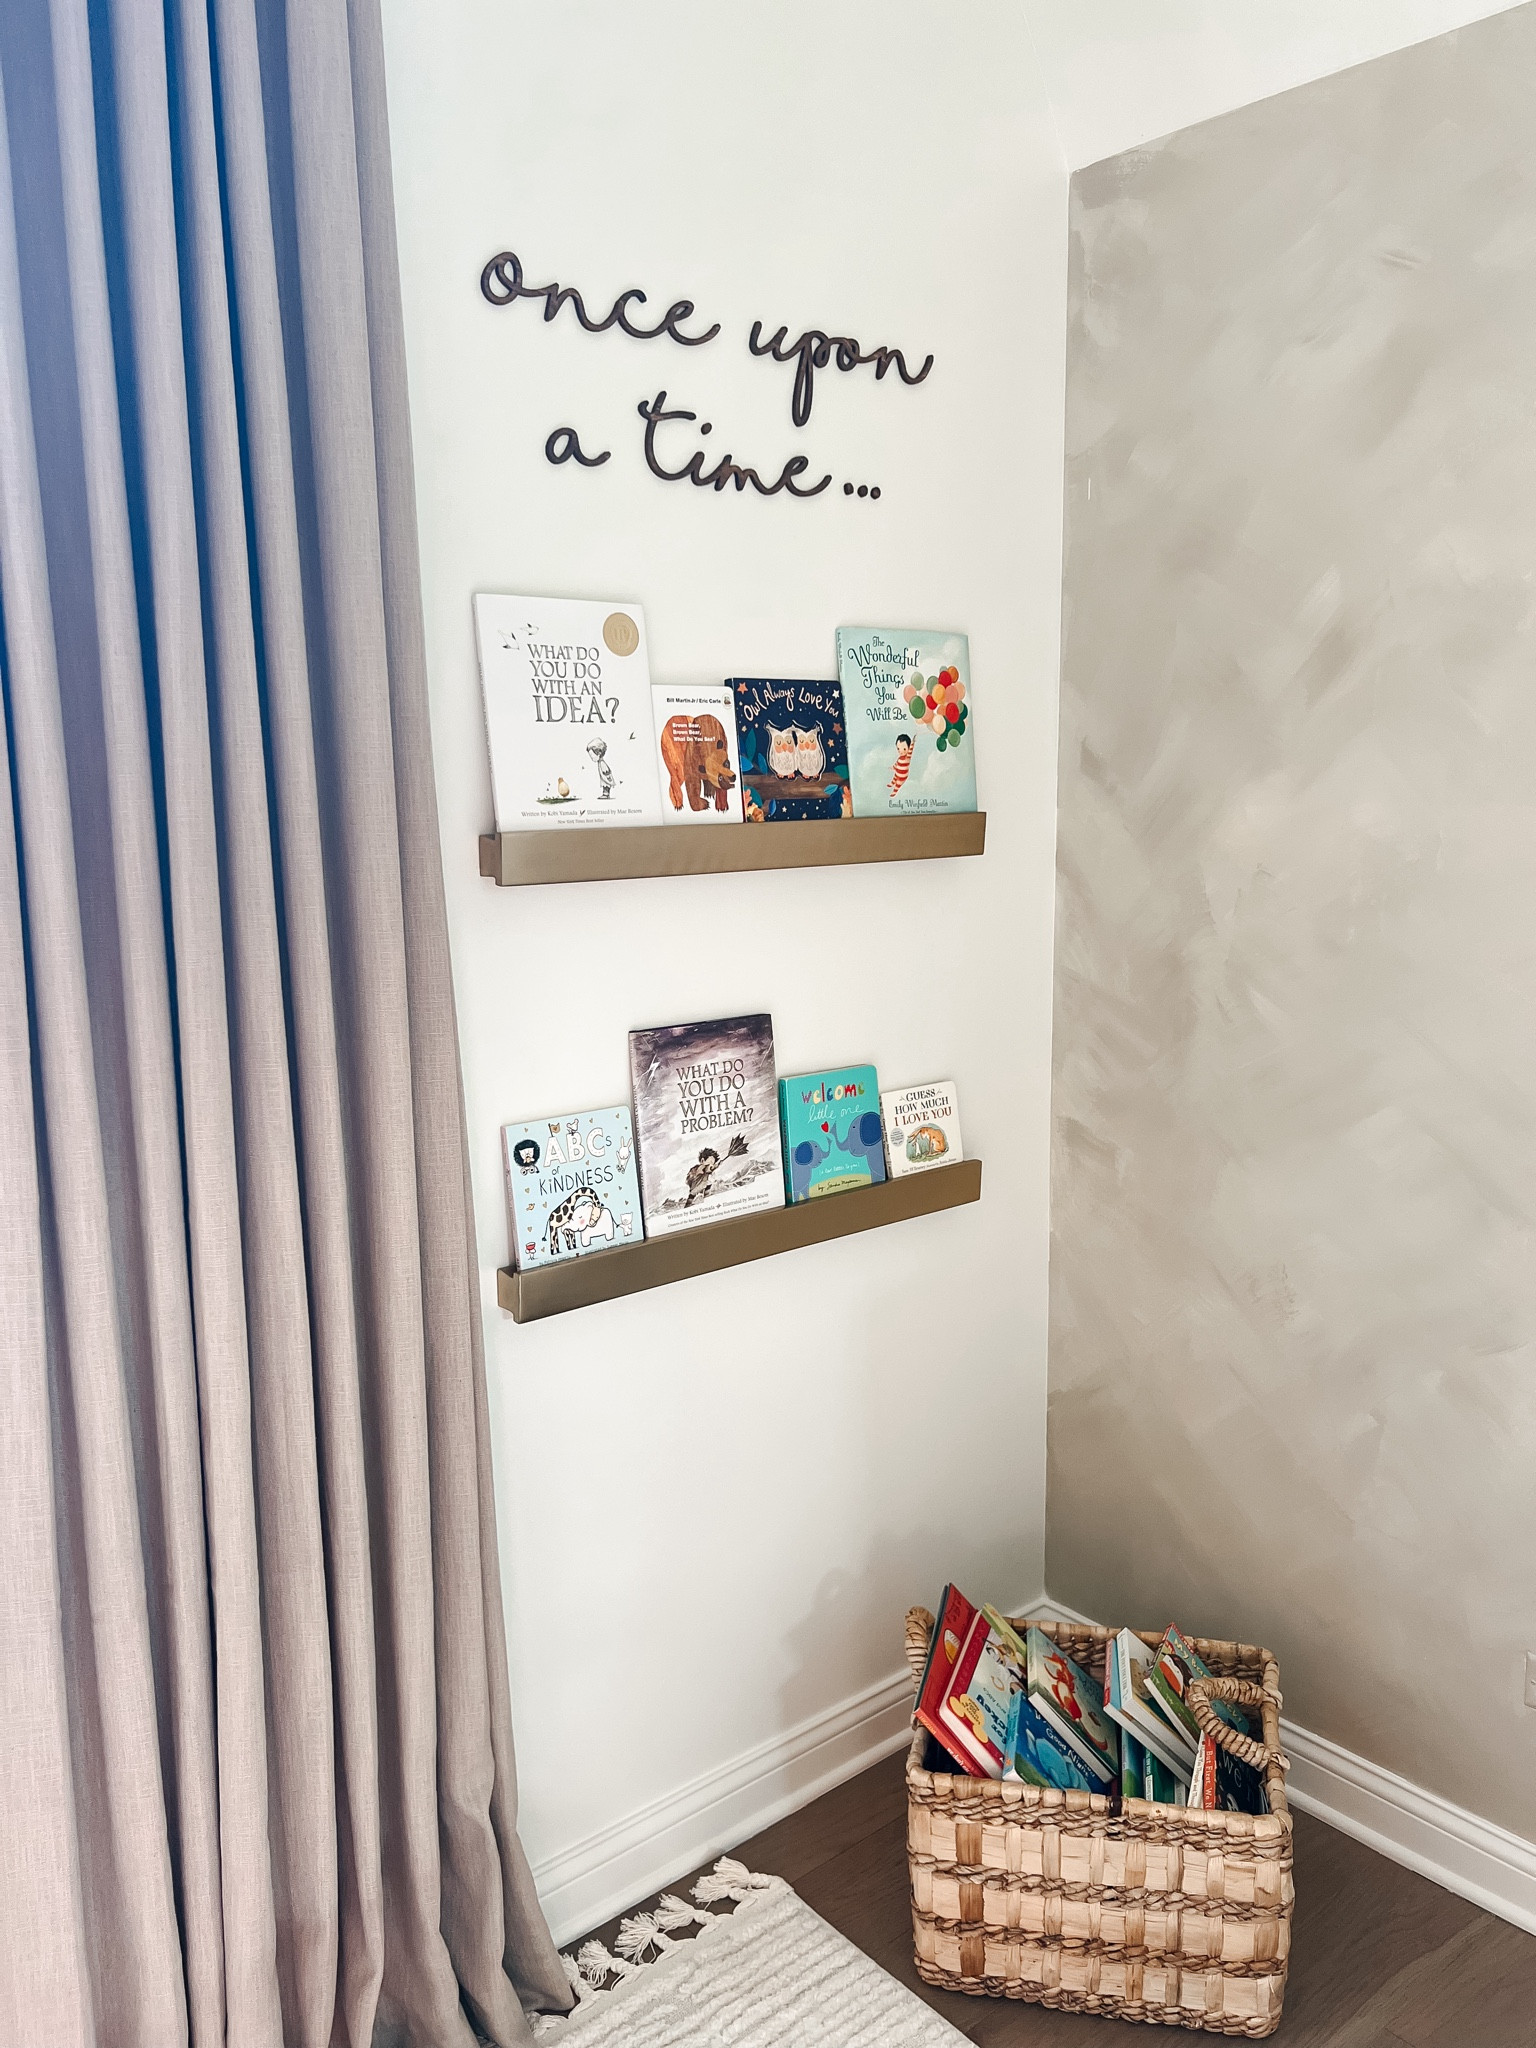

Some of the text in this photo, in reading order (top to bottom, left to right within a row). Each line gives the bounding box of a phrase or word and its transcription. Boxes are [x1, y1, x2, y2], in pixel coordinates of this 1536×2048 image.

[480, 251, 934, 427] once upon
[545, 390, 881, 500] a time...
[527, 644, 600, 661] WHAT DO
[872, 636, 885, 648] The
[847, 643, 920, 670] Wonderful
[529, 660, 601, 679] YOU DO
[861, 665, 905, 688] Things
[531, 678, 603, 696] WITH AN
[874, 686, 896, 705] You
[532, 695, 620, 724] IDEA?
[743, 687, 767, 721] Owl
[763, 681, 796, 711] Always
[798, 687, 823, 710] Love
[824, 698, 840, 718] You
[866, 706, 908, 722] Will Be
[675, 1058, 744, 1081] WHAT DO
[677, 1073, 746, 1099] YOU DO
[801, 1081, 865, 1105] welcome
[905, 1088, 936, 1102] GUESS
[679, 1090, 747, 1119] WITH A
[807, 1104, 865, 1124] little one
[894, 1096, 949, 1115] HOW MUCH
[681, 1107, 754, 1135] PROBLEM?
[894, 1106, 952, 1127] I LOVE YOU
